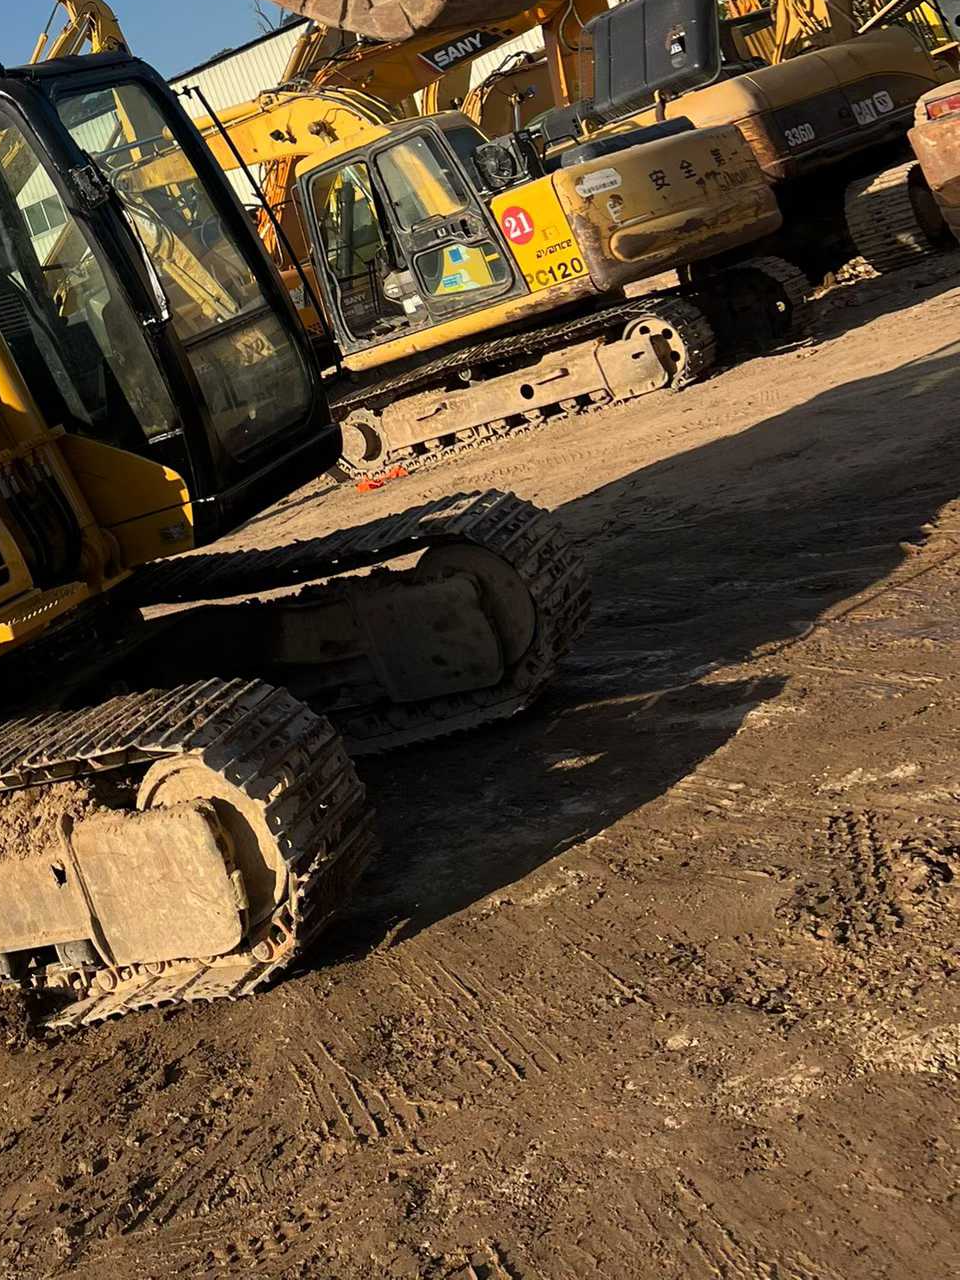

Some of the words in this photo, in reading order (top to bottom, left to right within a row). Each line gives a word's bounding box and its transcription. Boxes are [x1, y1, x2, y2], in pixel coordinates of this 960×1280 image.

[433, 33, 482, 68] SANY
[850, 98, 879, 126] CAT
[784, 122, 816, 147] 336D
[504, 211, 534, 239] 21
